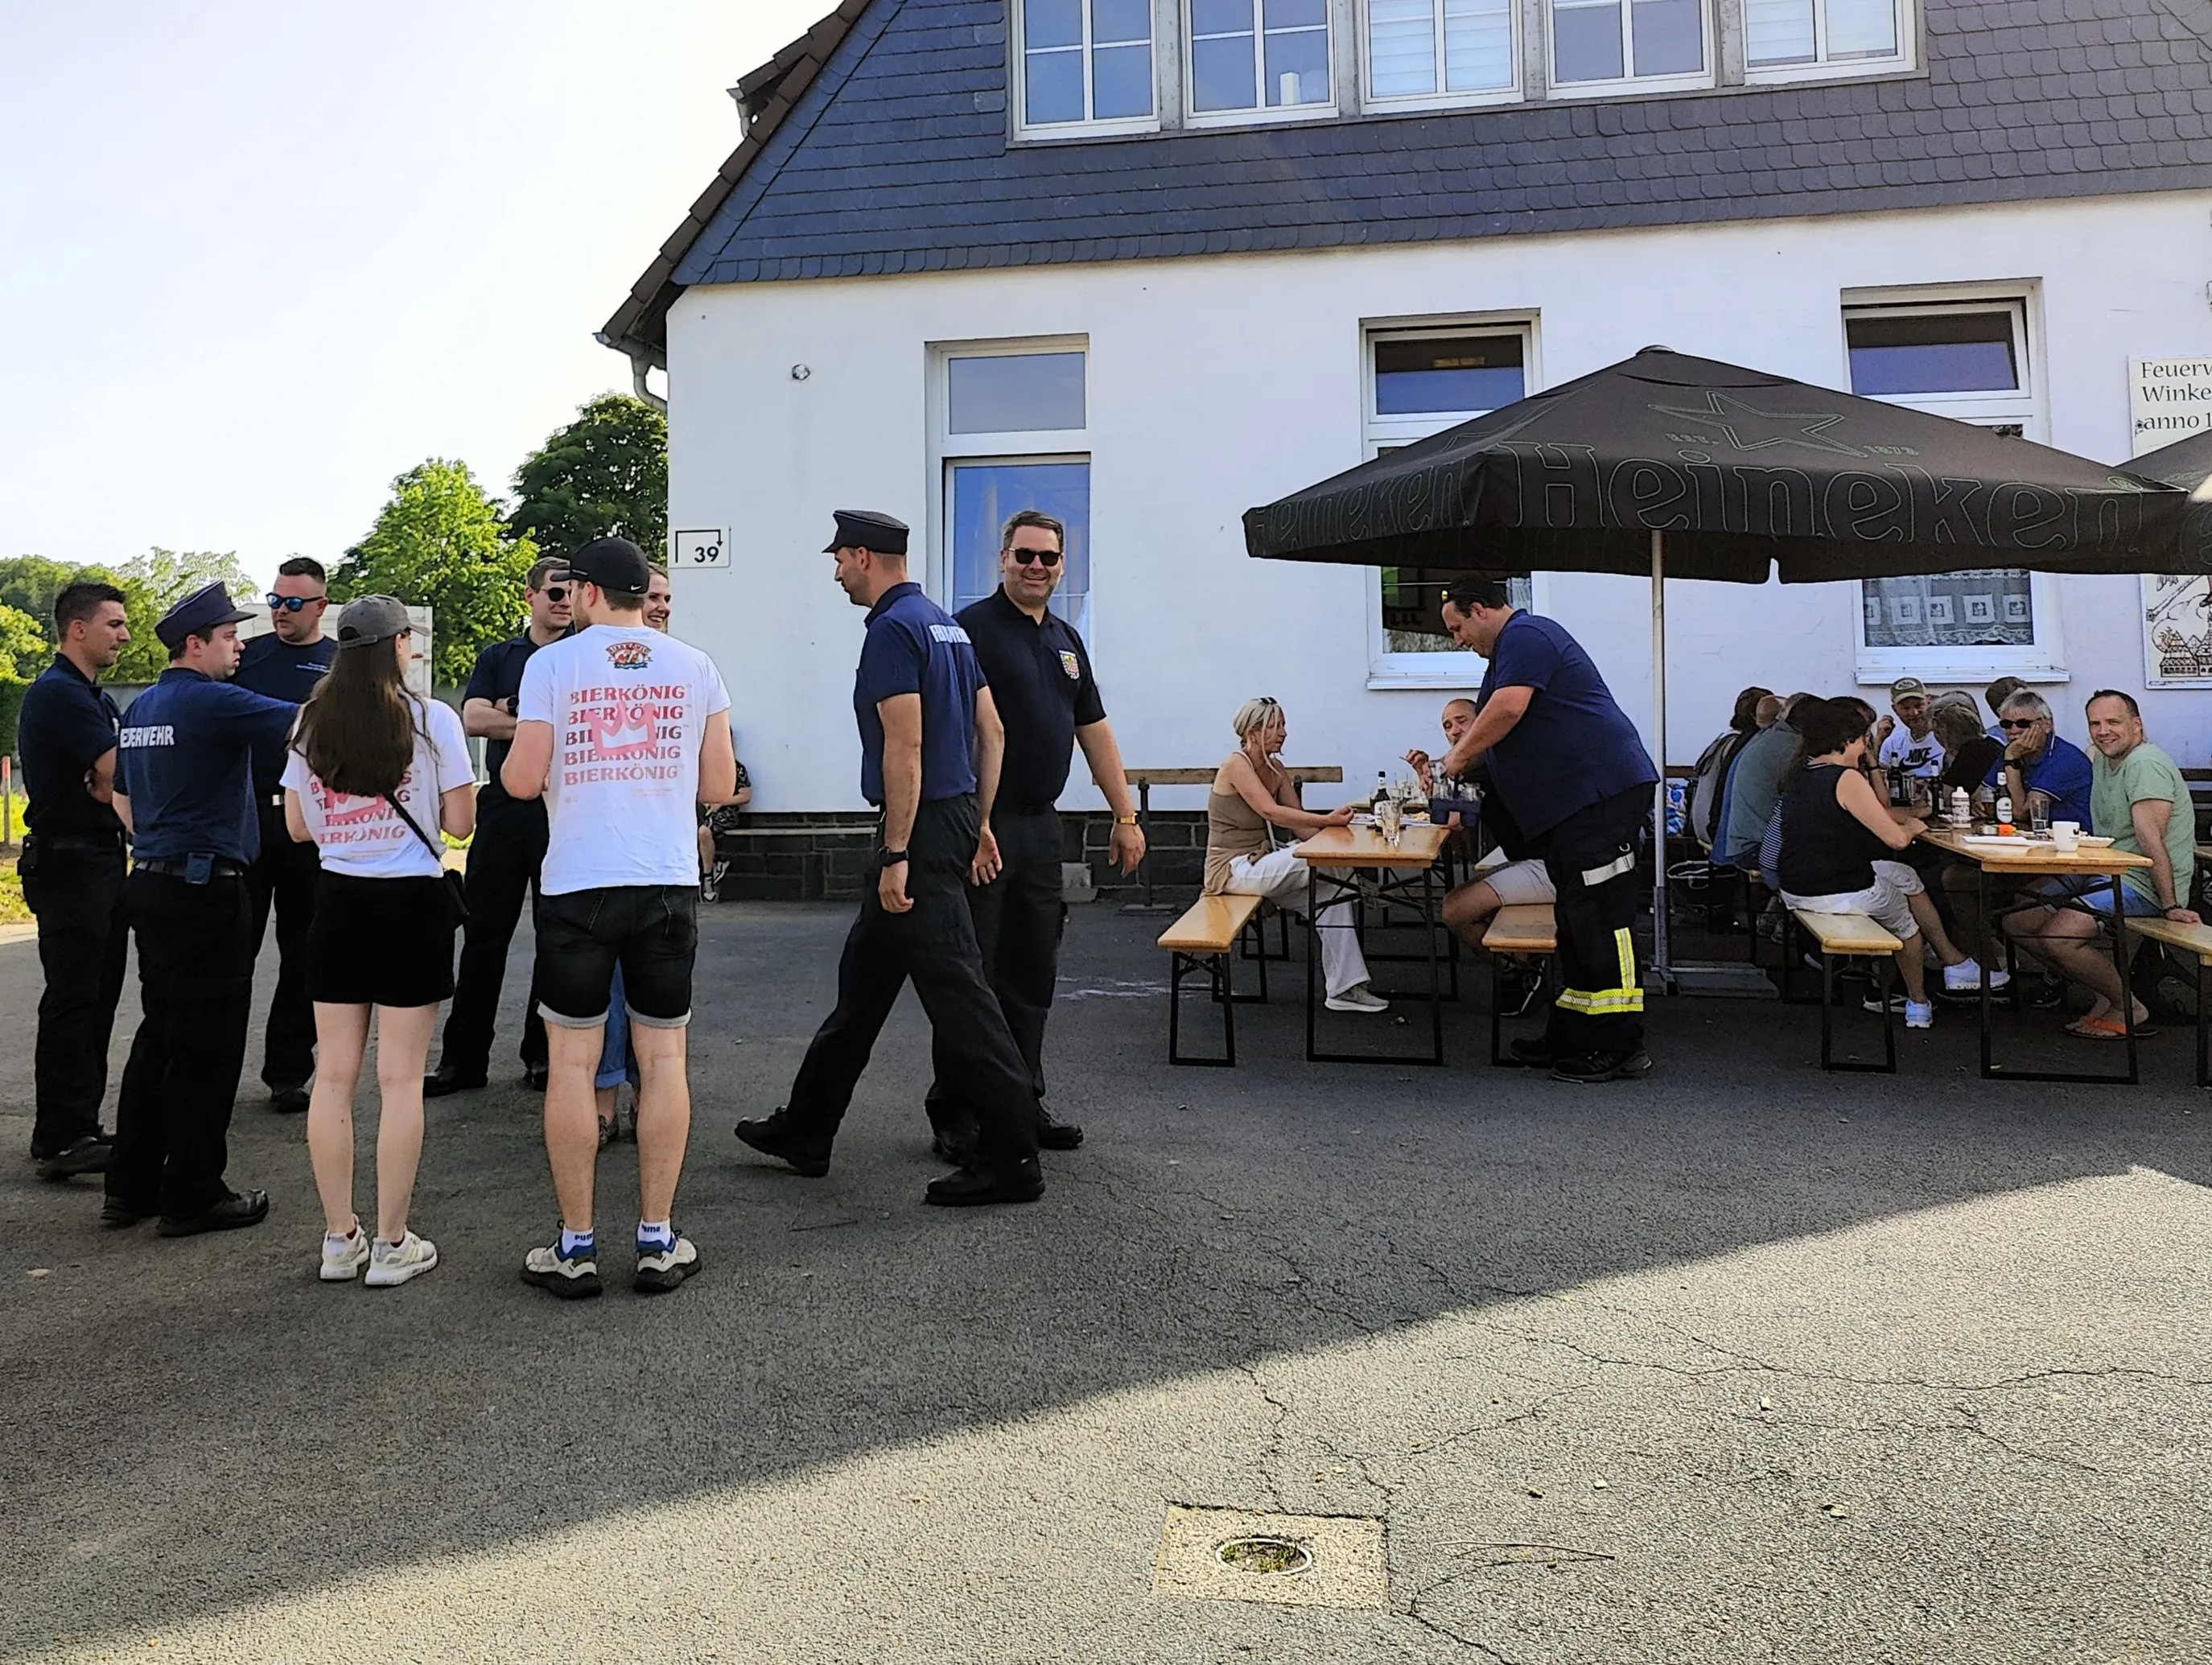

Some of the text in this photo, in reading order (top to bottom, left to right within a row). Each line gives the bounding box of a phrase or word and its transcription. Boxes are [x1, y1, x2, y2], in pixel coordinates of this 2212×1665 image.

[2144, 415, 2199, 430] anno
[1495, 439, 2145, 552] Heineken
[694, 546, 719, 563] 39
[570, 684, 685, 705] BIERKÖNIG
[563, 764, 678, 786] BIERKÖNIG
